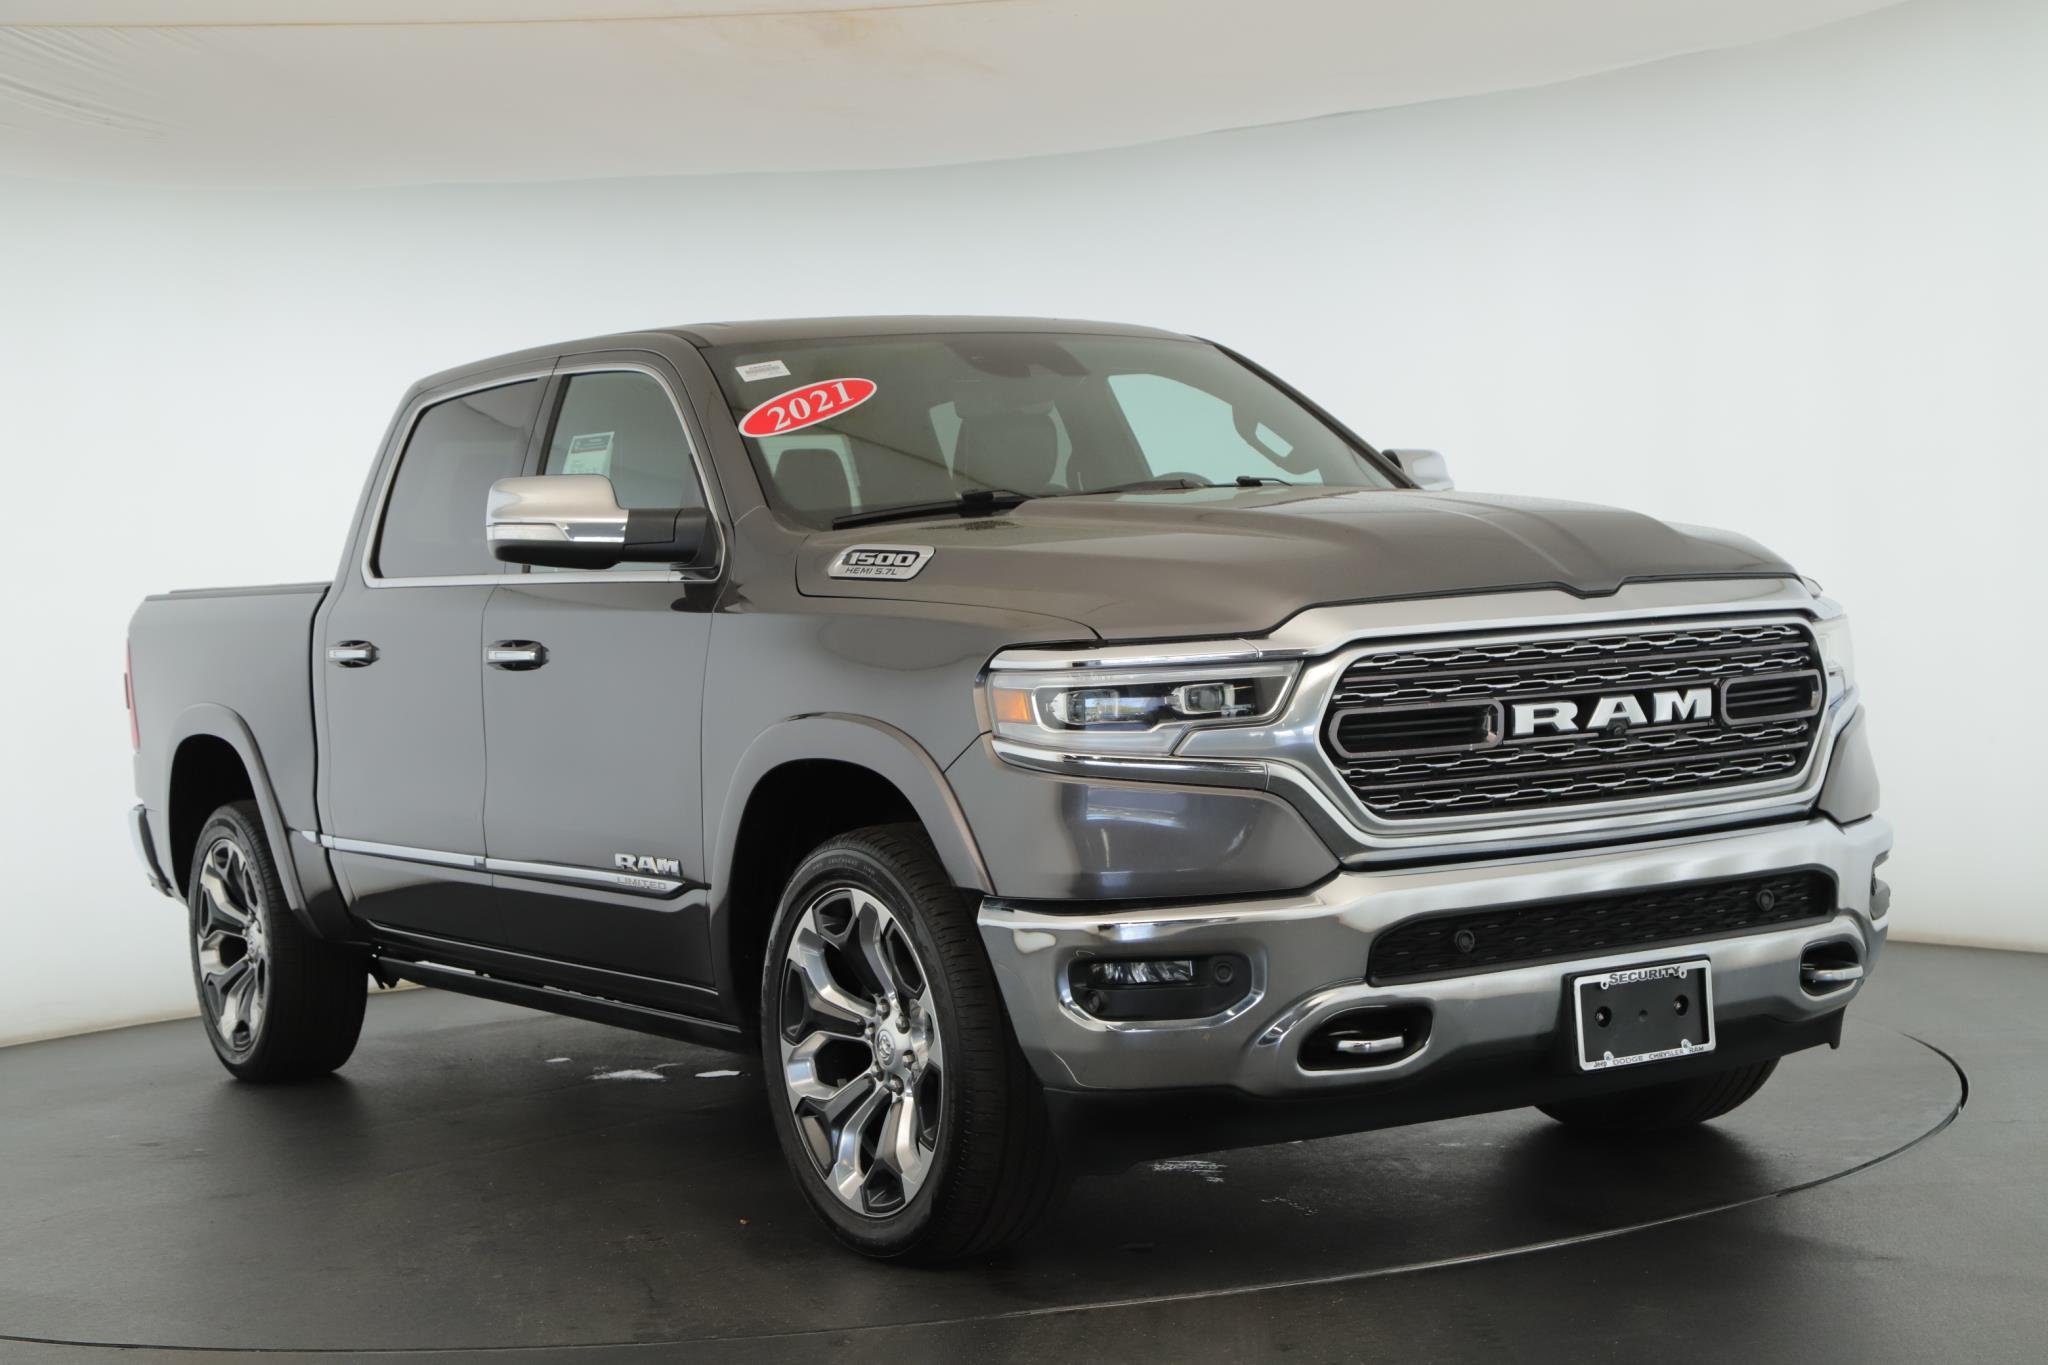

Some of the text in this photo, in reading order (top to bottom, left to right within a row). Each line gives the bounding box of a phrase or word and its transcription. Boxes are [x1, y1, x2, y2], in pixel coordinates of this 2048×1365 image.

[767, 381, 854, 431] 2021
[847, 552, 917, 567] 1500
[844, 567, 897, 576] HEMI 5.7L
[1512, 687, 1713, 736] RAM
[614, 853, 682, 876] RAM
[617, 876, 667, 890] LIMITED
[1608, 966, 1681, 985] SECURITY
[1613, 1055, 1644, 1066] DODGE
[1648, 1048, 1684, 1060] CHRYSLER
